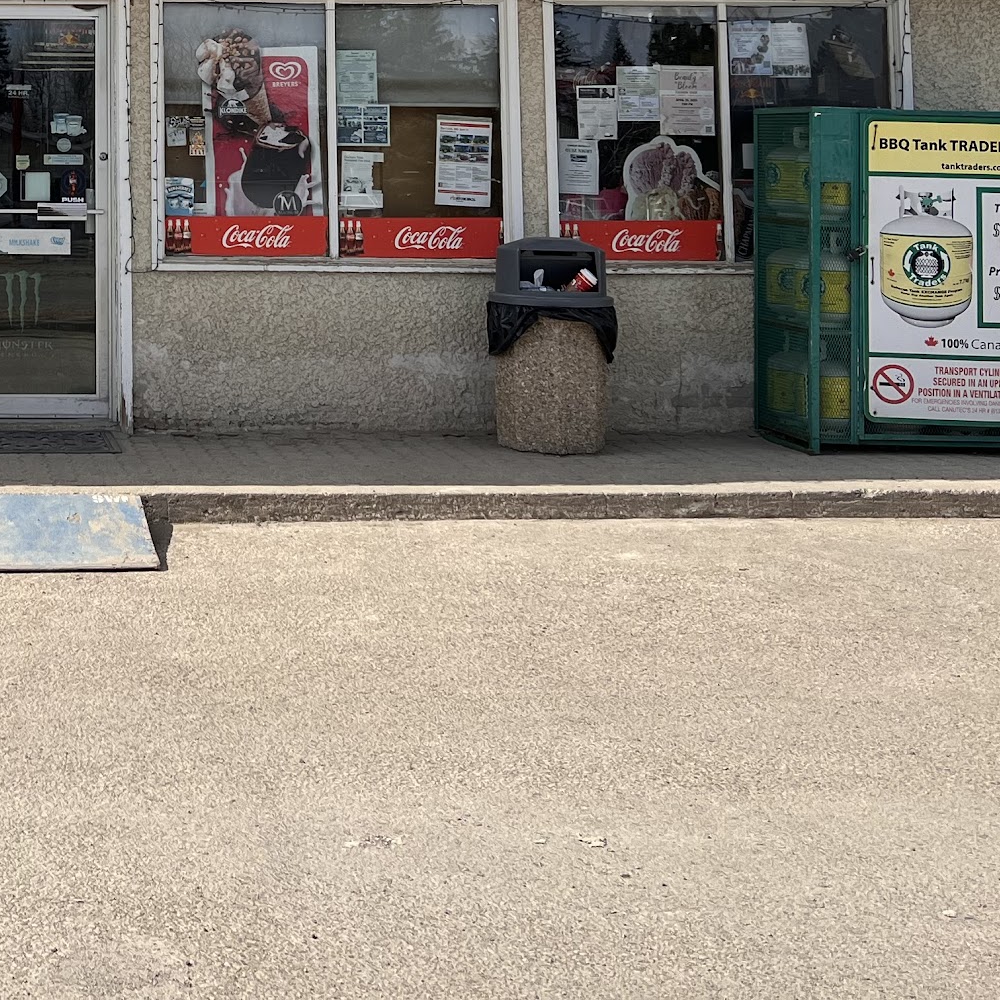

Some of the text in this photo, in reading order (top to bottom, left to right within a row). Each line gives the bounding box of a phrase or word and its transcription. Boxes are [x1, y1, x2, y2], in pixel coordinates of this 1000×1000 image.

[219, 106, 247, 115] KLONDIKE
[879, 138, 909, 152] BBQ
[912, 139, 947, 151] Tank
[222, 224, 295, 249] Coca-Cola
[394, 225, 467, 250] Coca-Cola
[611, 228, 684, 253] Coca-Cola
[8, 238, 40, 247] MILKSHAKE
[912, 241, 940, 252] Tank
[908, 272, 947, 287] Traders
[941, 338, 969, 349] 100%
[934, 366, 978, 376] TRANSPORT
[933, 377, 966, 387] SECURED
[968, 378, 976, 387] IN
[977, 378, 988, 388] AN
[918, 387, 951, 397] POSITION
[953, 389, 961, 398] IN
[962, 389, 968, 398] A
[923, 398, 960, 406] EMERGENCIES
